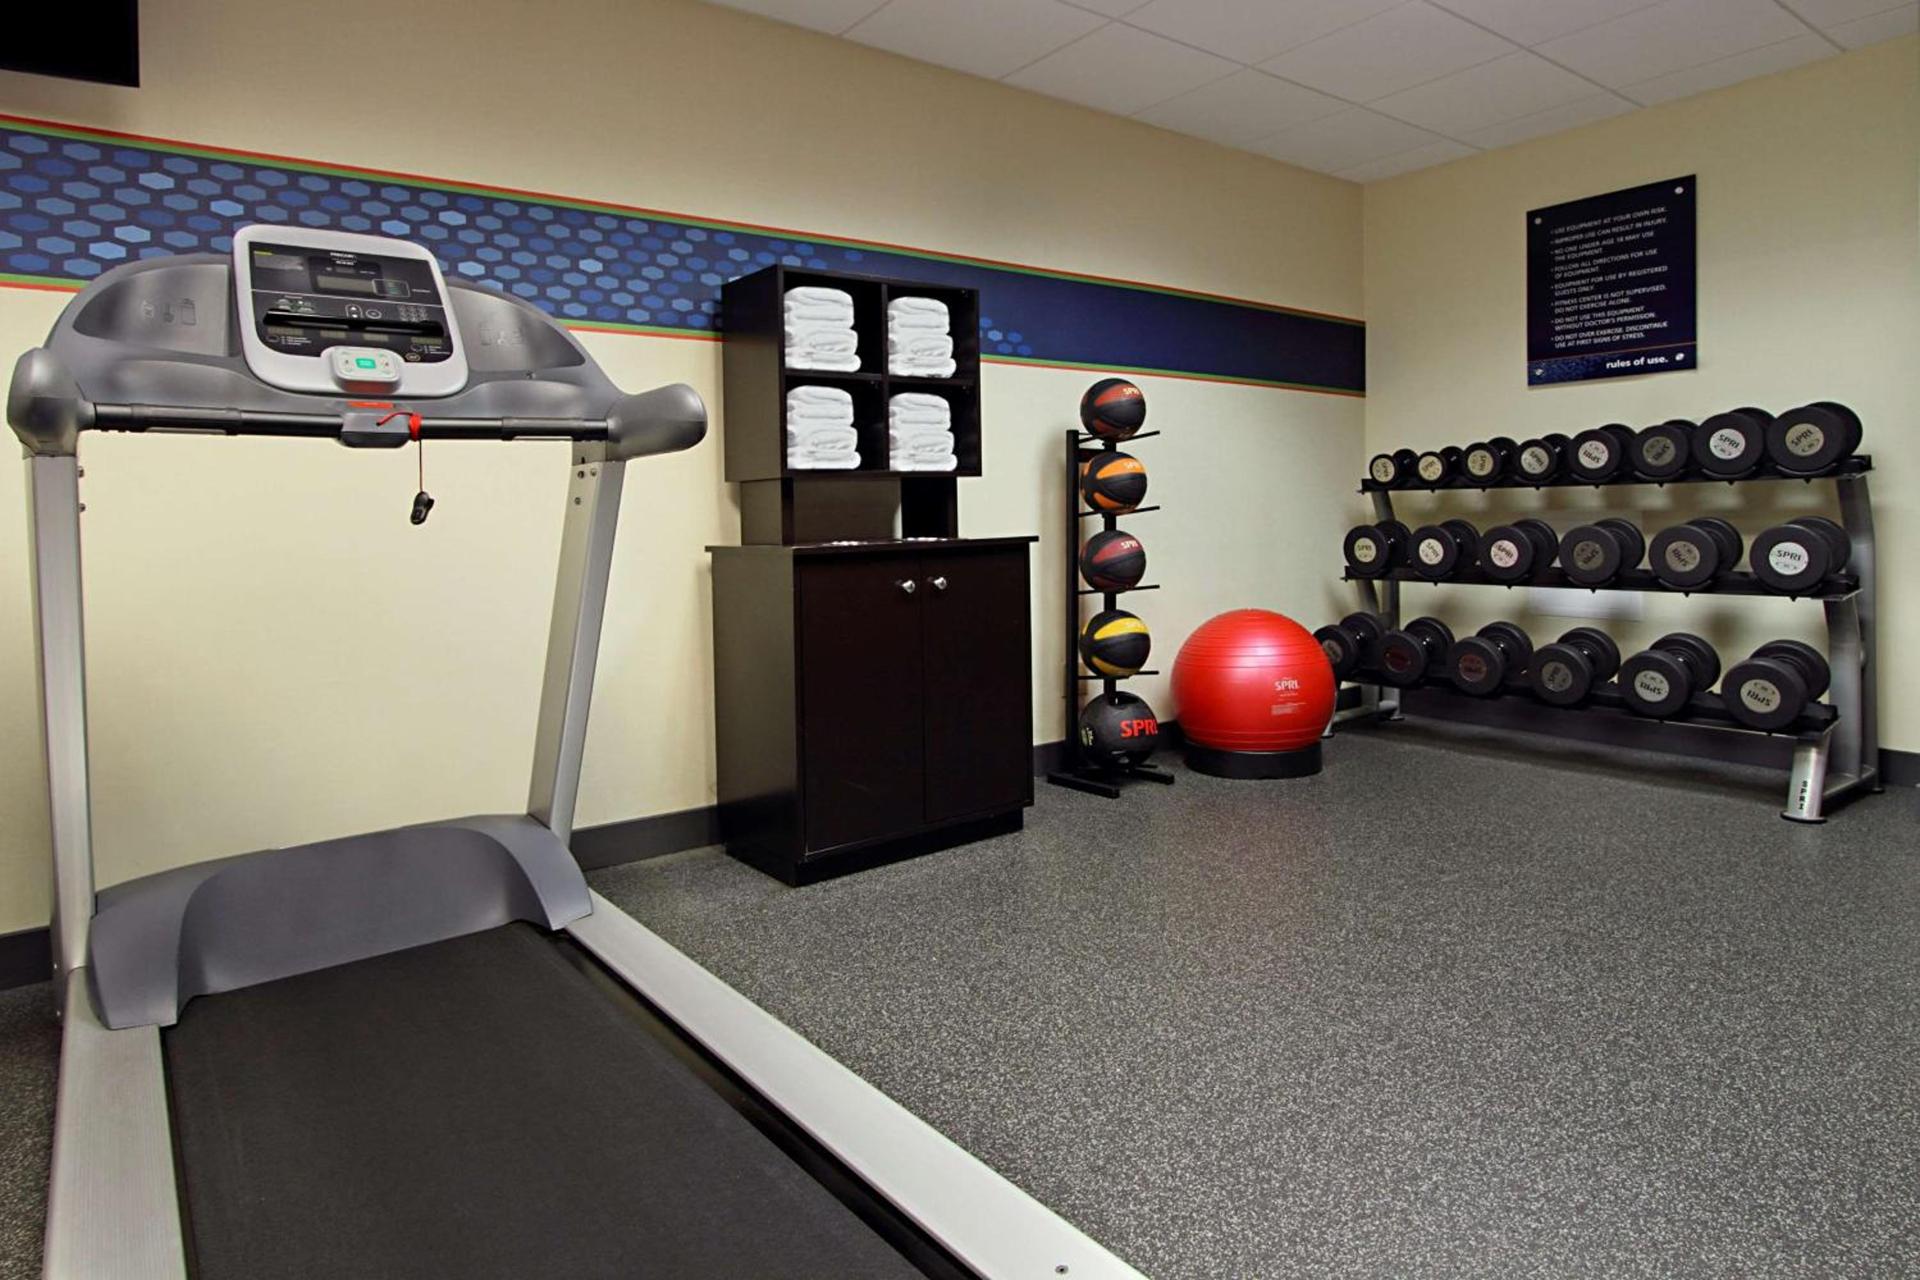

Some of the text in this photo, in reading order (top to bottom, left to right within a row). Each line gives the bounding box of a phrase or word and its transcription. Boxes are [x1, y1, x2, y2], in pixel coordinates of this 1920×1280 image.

[1612, 224, 1634, 232] RESULT
[1592, 254, 1629, 265] DIRECTIONS
[1554, 279, 1590, 289] EQUIPMENT
[1628, 266, 1668, 276] REGISTERED
[1579, 294, 1602, 303] CENTER
[1607, 306, 1644, 316] EQUIPMENT
[1555, 322, 1583, 331] WITHOUT
[1606, 356, 1668, 369] rules of use.
[1718, 434, 1740, 449] SPRI
[1791, 428, 1813, 446] SPRI
[1776, 550, 1802, 561] SPRI
[1274, 680, 1299, 690] SPRI
[1640, 682, 1664, 695] SPRI
[1746, 690, 1771, 706] SPRI
[1798, 780, 1808, 810] SPRI
